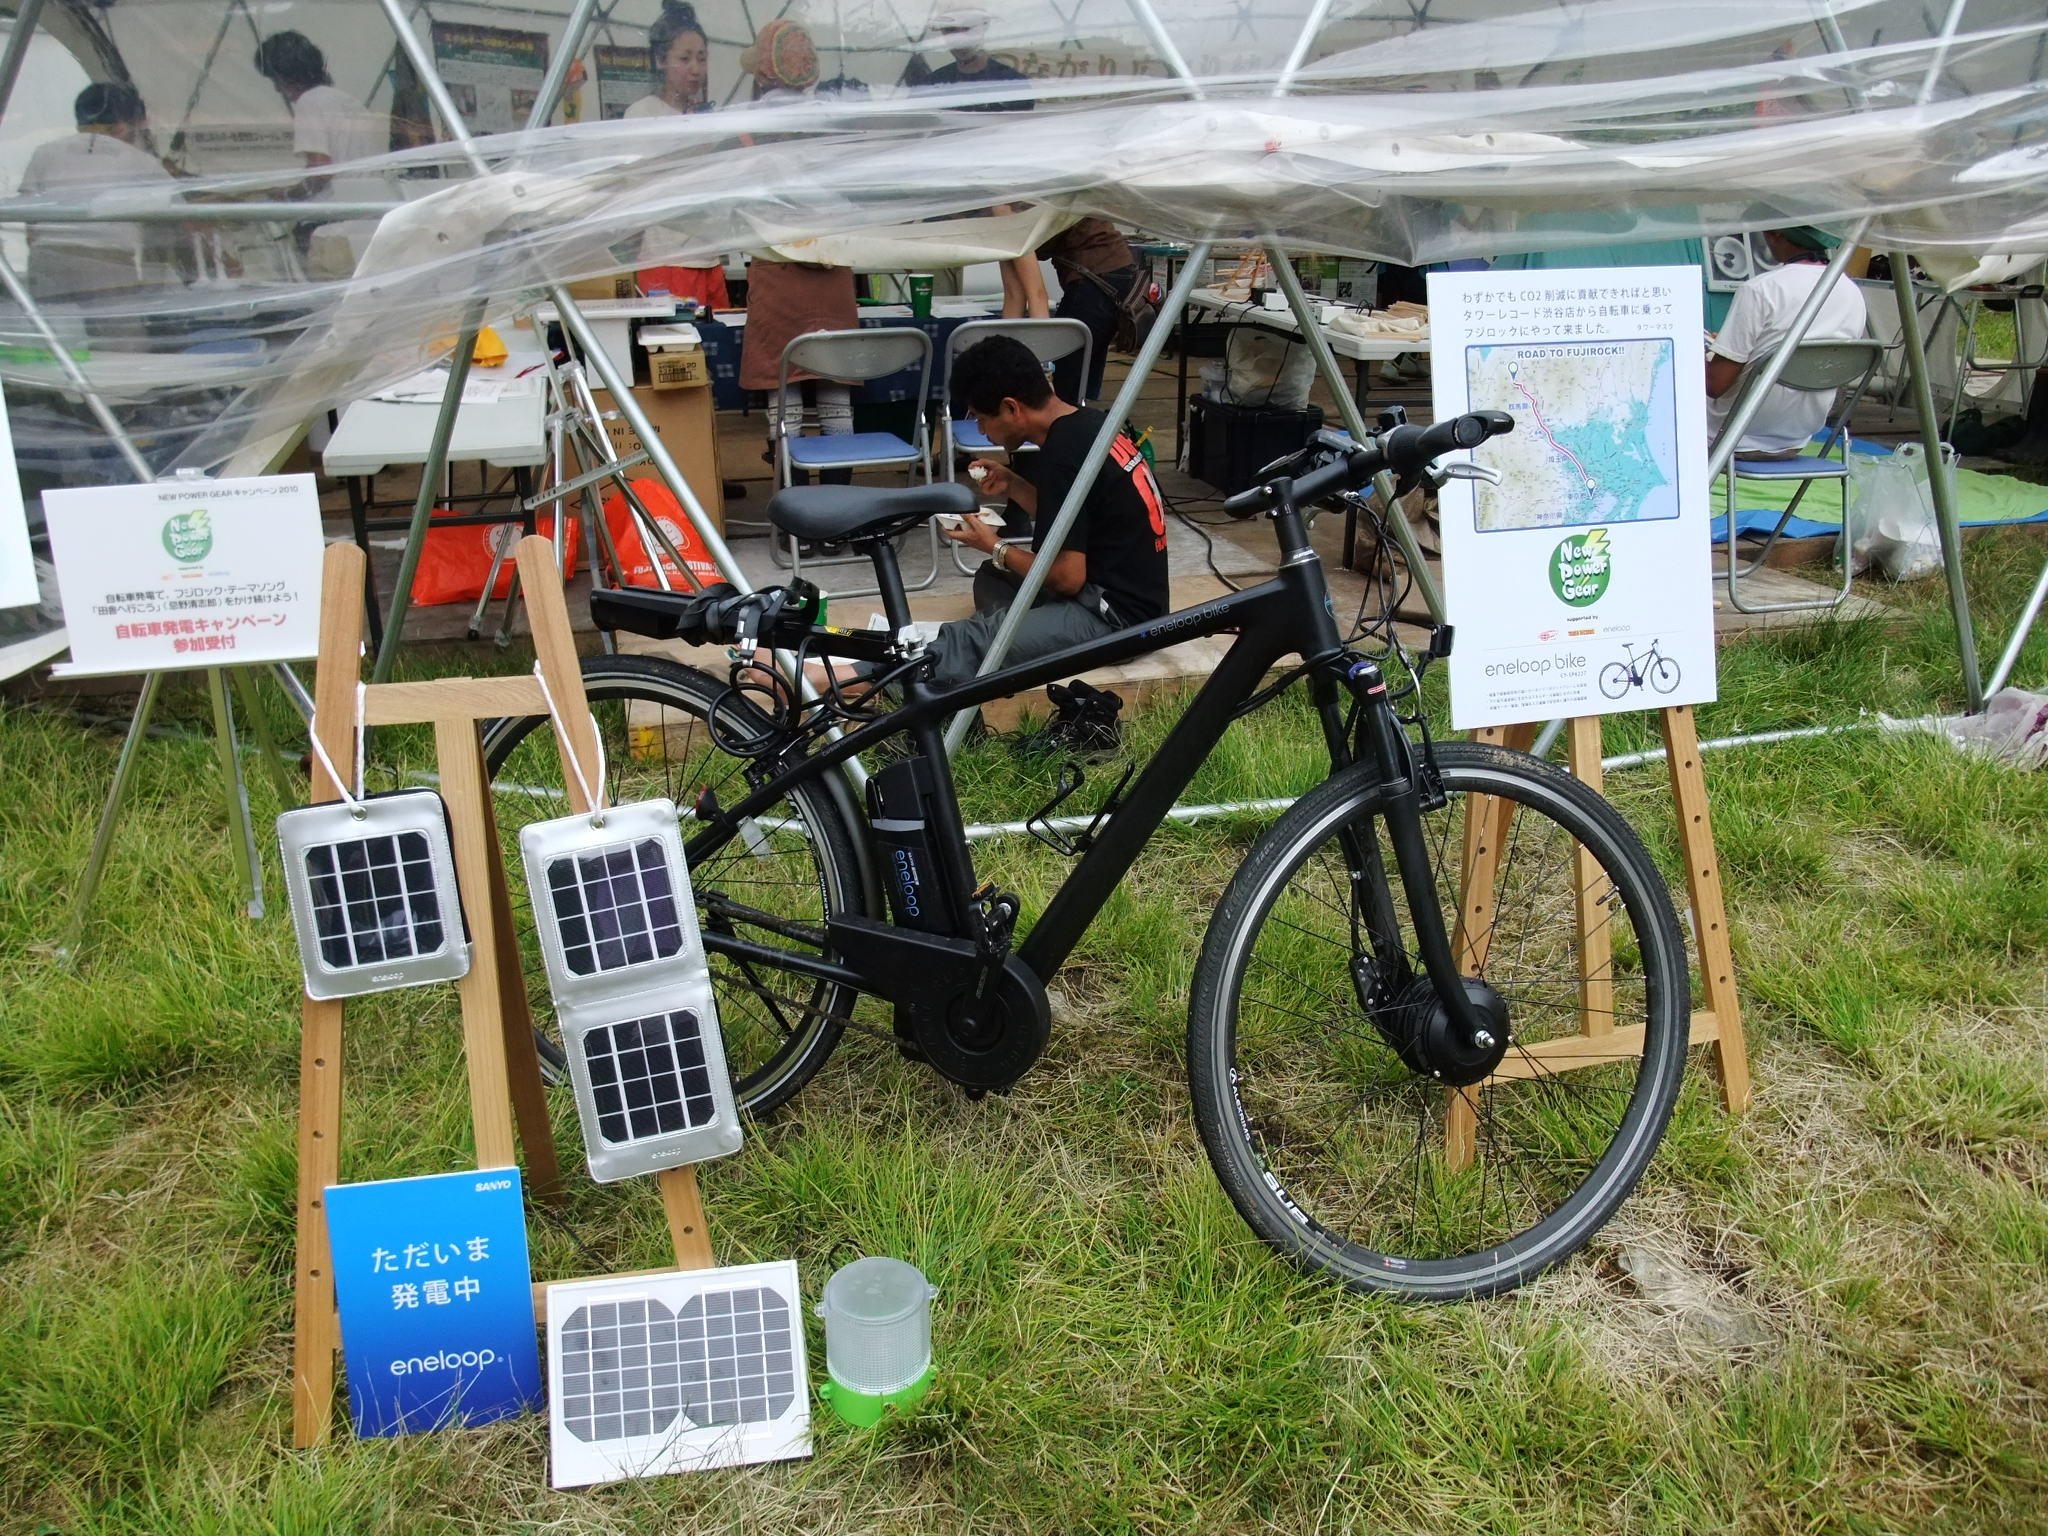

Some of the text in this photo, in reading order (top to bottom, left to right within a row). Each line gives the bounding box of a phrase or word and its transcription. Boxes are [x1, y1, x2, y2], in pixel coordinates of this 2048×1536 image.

[1463, 303, 1672, 322] タワーレコード渋谷店から自転車に乗って
[1517, 346, 1625, 359] ROAD TO FUJIROCK!!
[158, 493, 177, 502] NEW
[178, 491, 208, 501] POWER
[210, 489, 233, 498] GEAR
[278, 485, 299, 494] 2010
[1560, 540, 1594, 563] New
[1558, 561, 1608, 583] Power
[1562, 579, 1600, 601] Gear
[115, 612, 287, 640] 自転車発電キャンペーン
[1150, 602, 1231, 638] eneloop bike
[173, 633, 237, 654] 参加受付
[1485, 651, 1587, 677] eneloop bike
[894, 849, 921, 918] eneloop
[1232, 1085, 1251, 1142] ALEXRIMS
[475, 1178, 512, 1193] SANYO
[370, 1235, 491, 1273] ただいま
[390, 1275, 481, 1311] 発電中
[389, 1347, 497, 1377] eneloop
